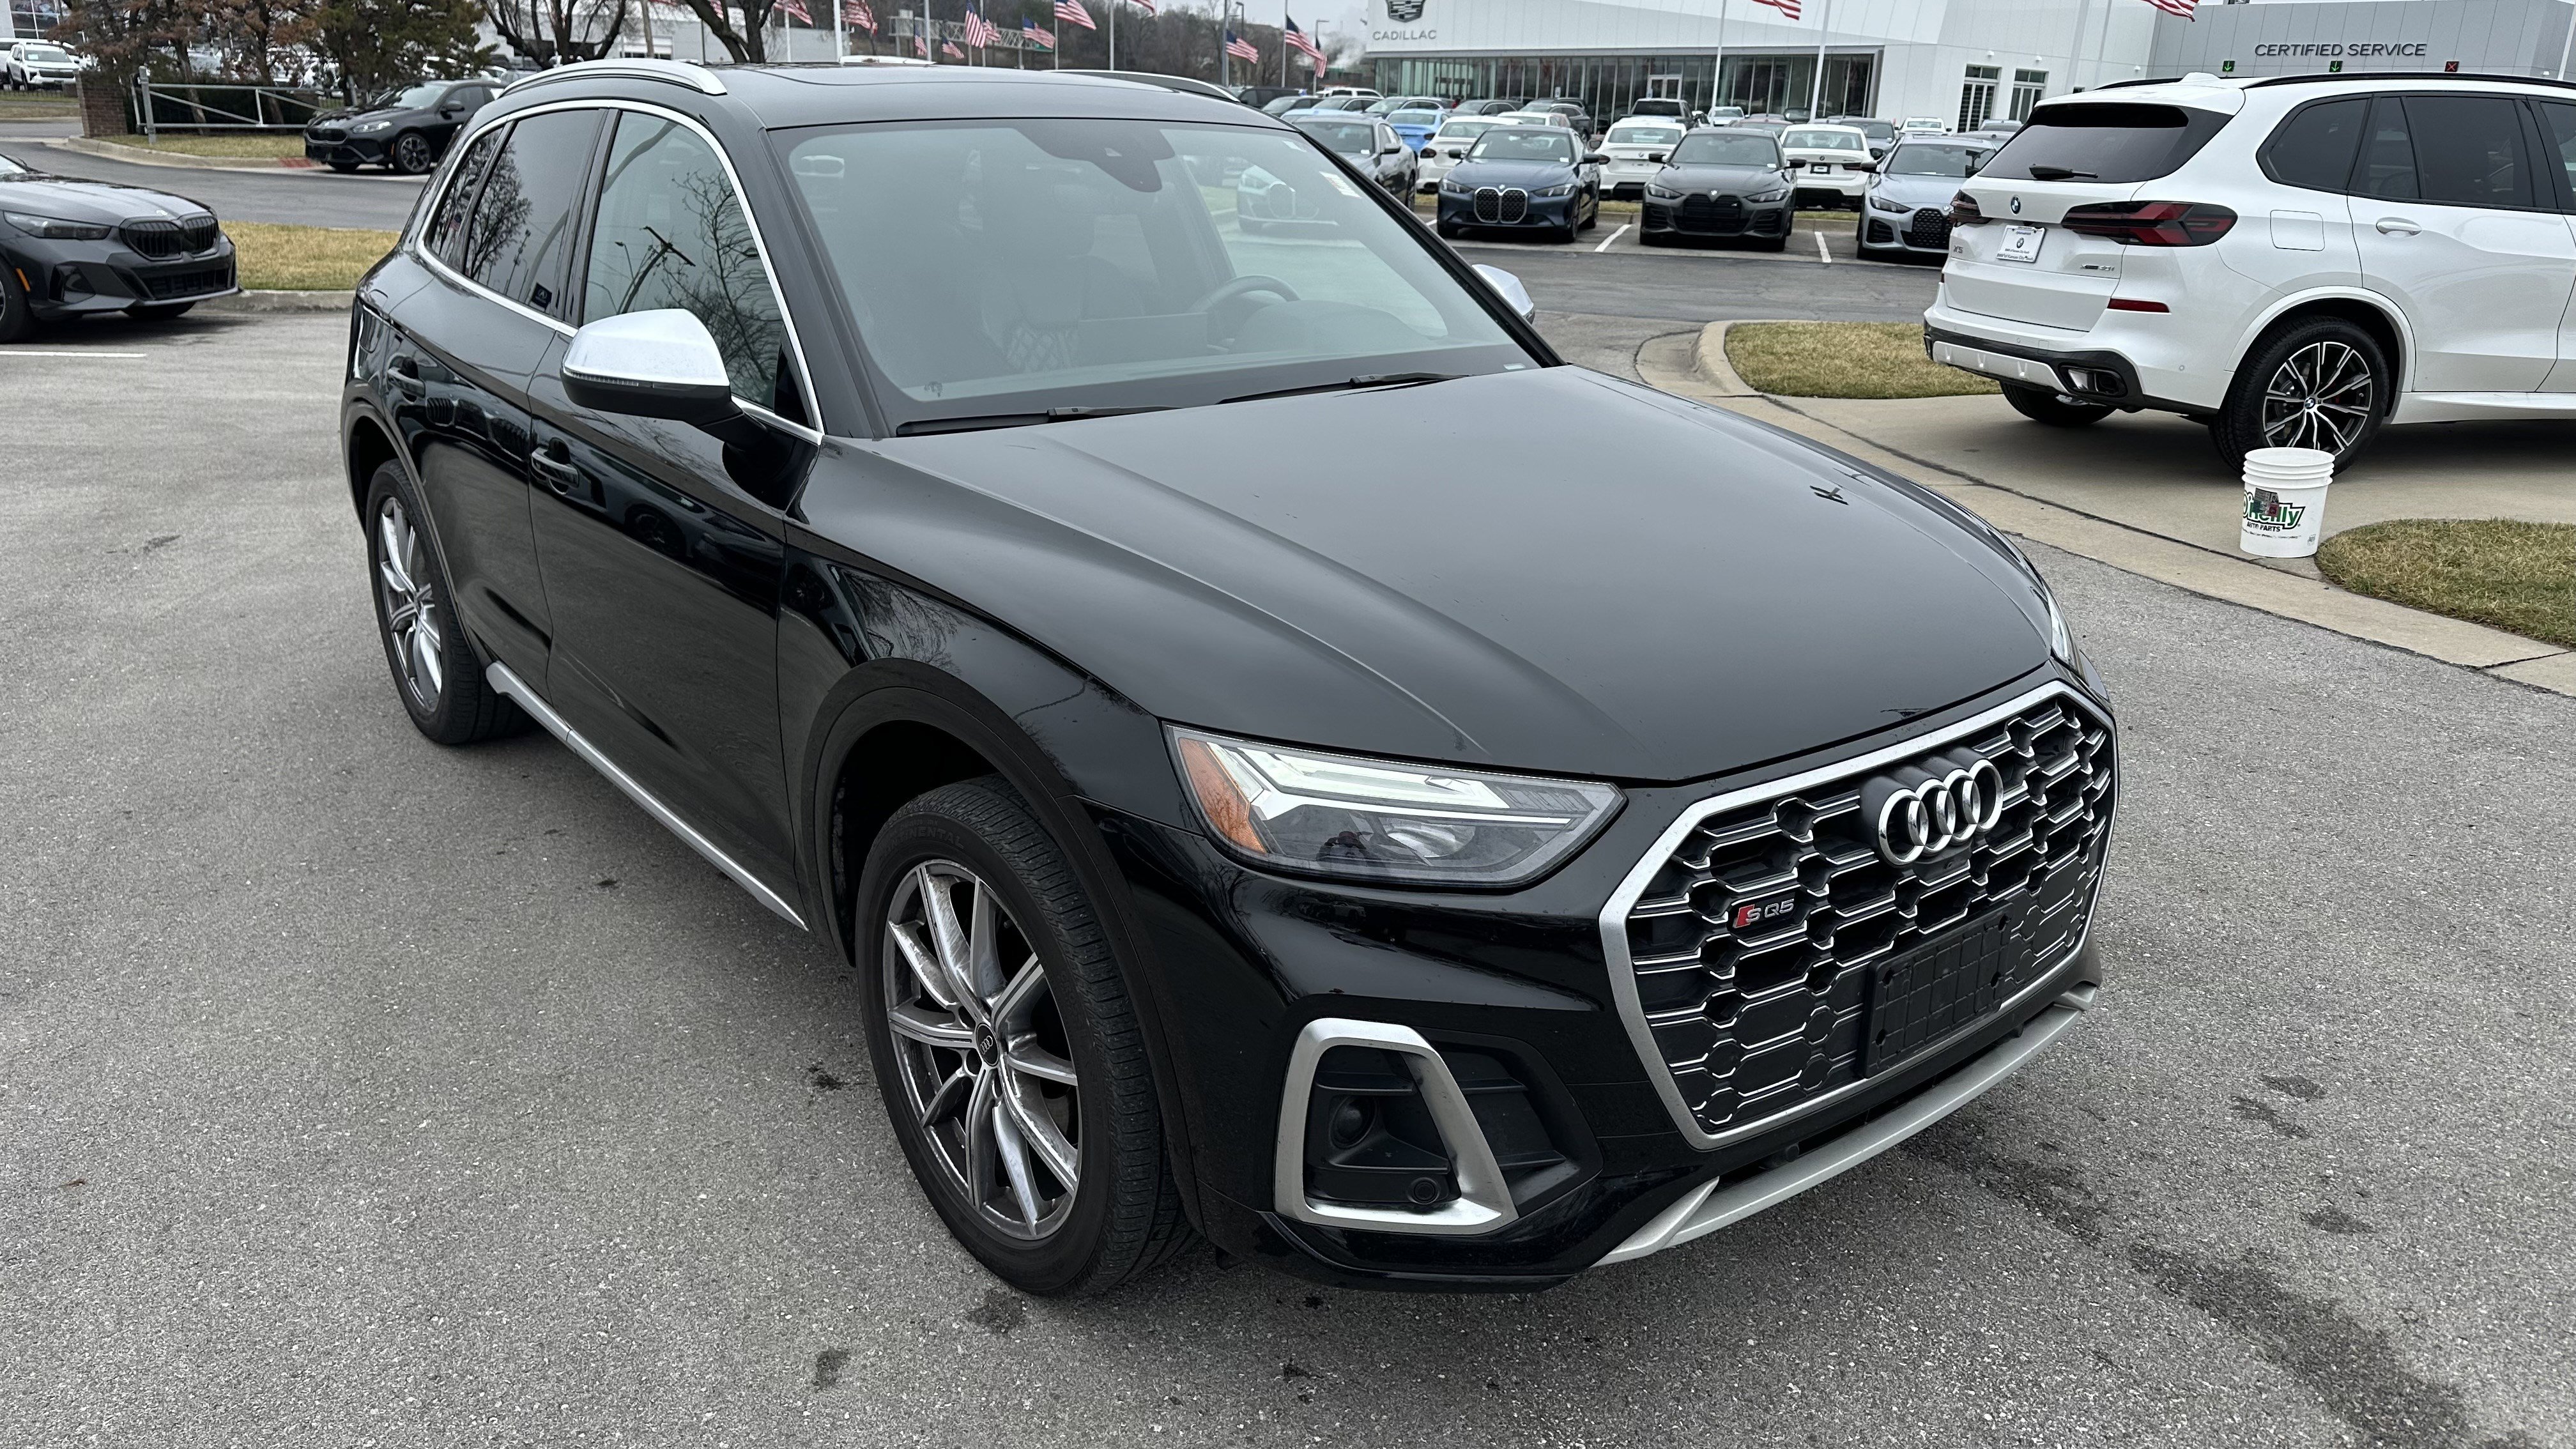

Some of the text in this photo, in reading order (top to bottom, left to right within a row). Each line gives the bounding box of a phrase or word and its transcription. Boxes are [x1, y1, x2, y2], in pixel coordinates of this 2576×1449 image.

[1372, 29, 1437, 40] CADILLAC
[2254, 43, 2427, 56] CERTIFIED SERVICE
[1744, 898, 1795, 923] SQ5
